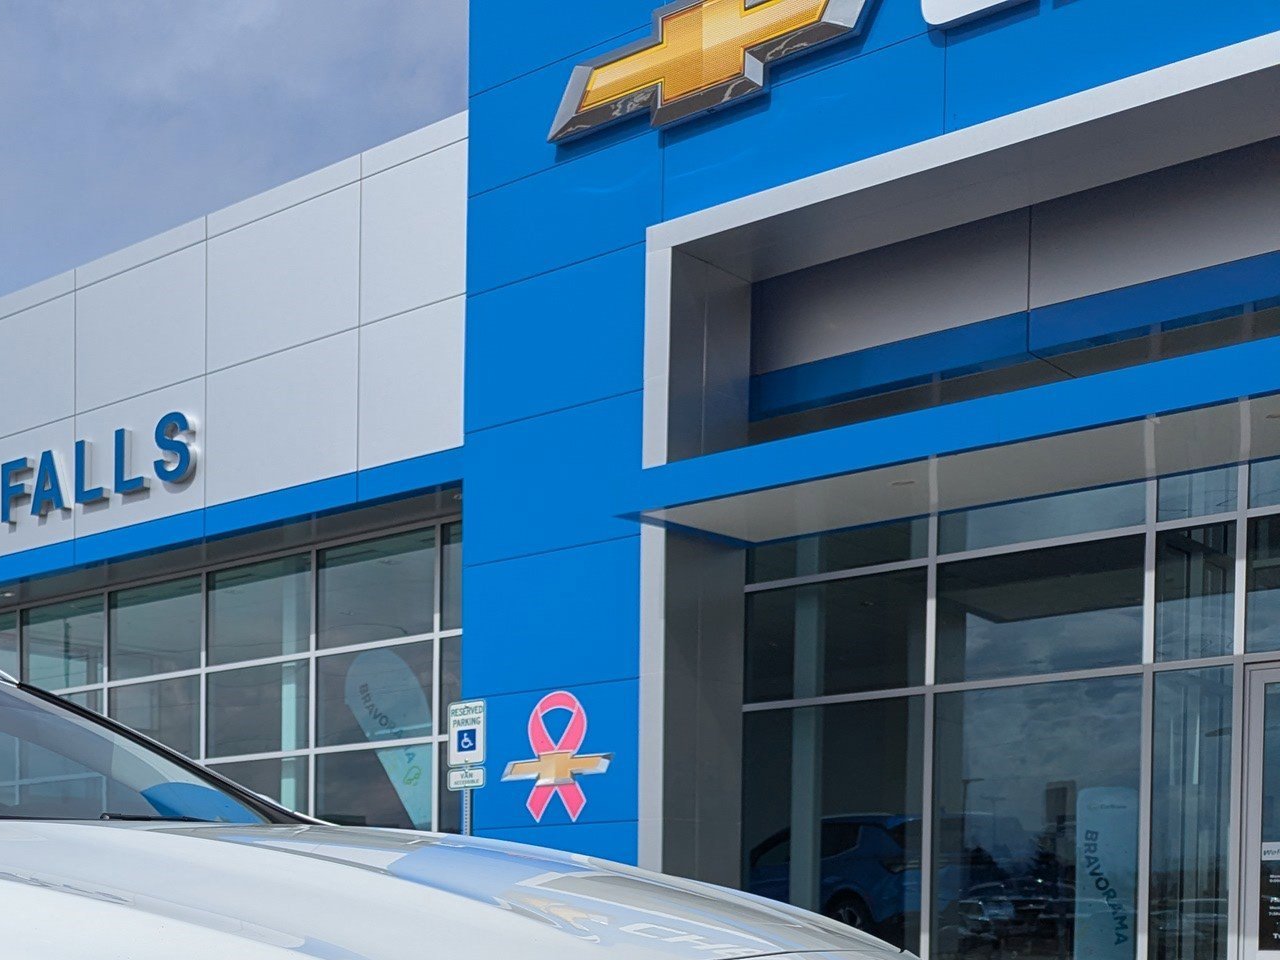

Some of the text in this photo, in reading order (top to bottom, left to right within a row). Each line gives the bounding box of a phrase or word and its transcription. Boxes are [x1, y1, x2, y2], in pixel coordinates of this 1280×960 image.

[1, 411, 199, 524] FALLS
[360, 682, 416, 764] BRAVORAA
[451, 705, 485, 717] RESERVED
[452, 717, 481, 728] PARKING
[460, 771, 474, 779] VAN
[1084, 829, 1129, 946] BRAVORAMA
